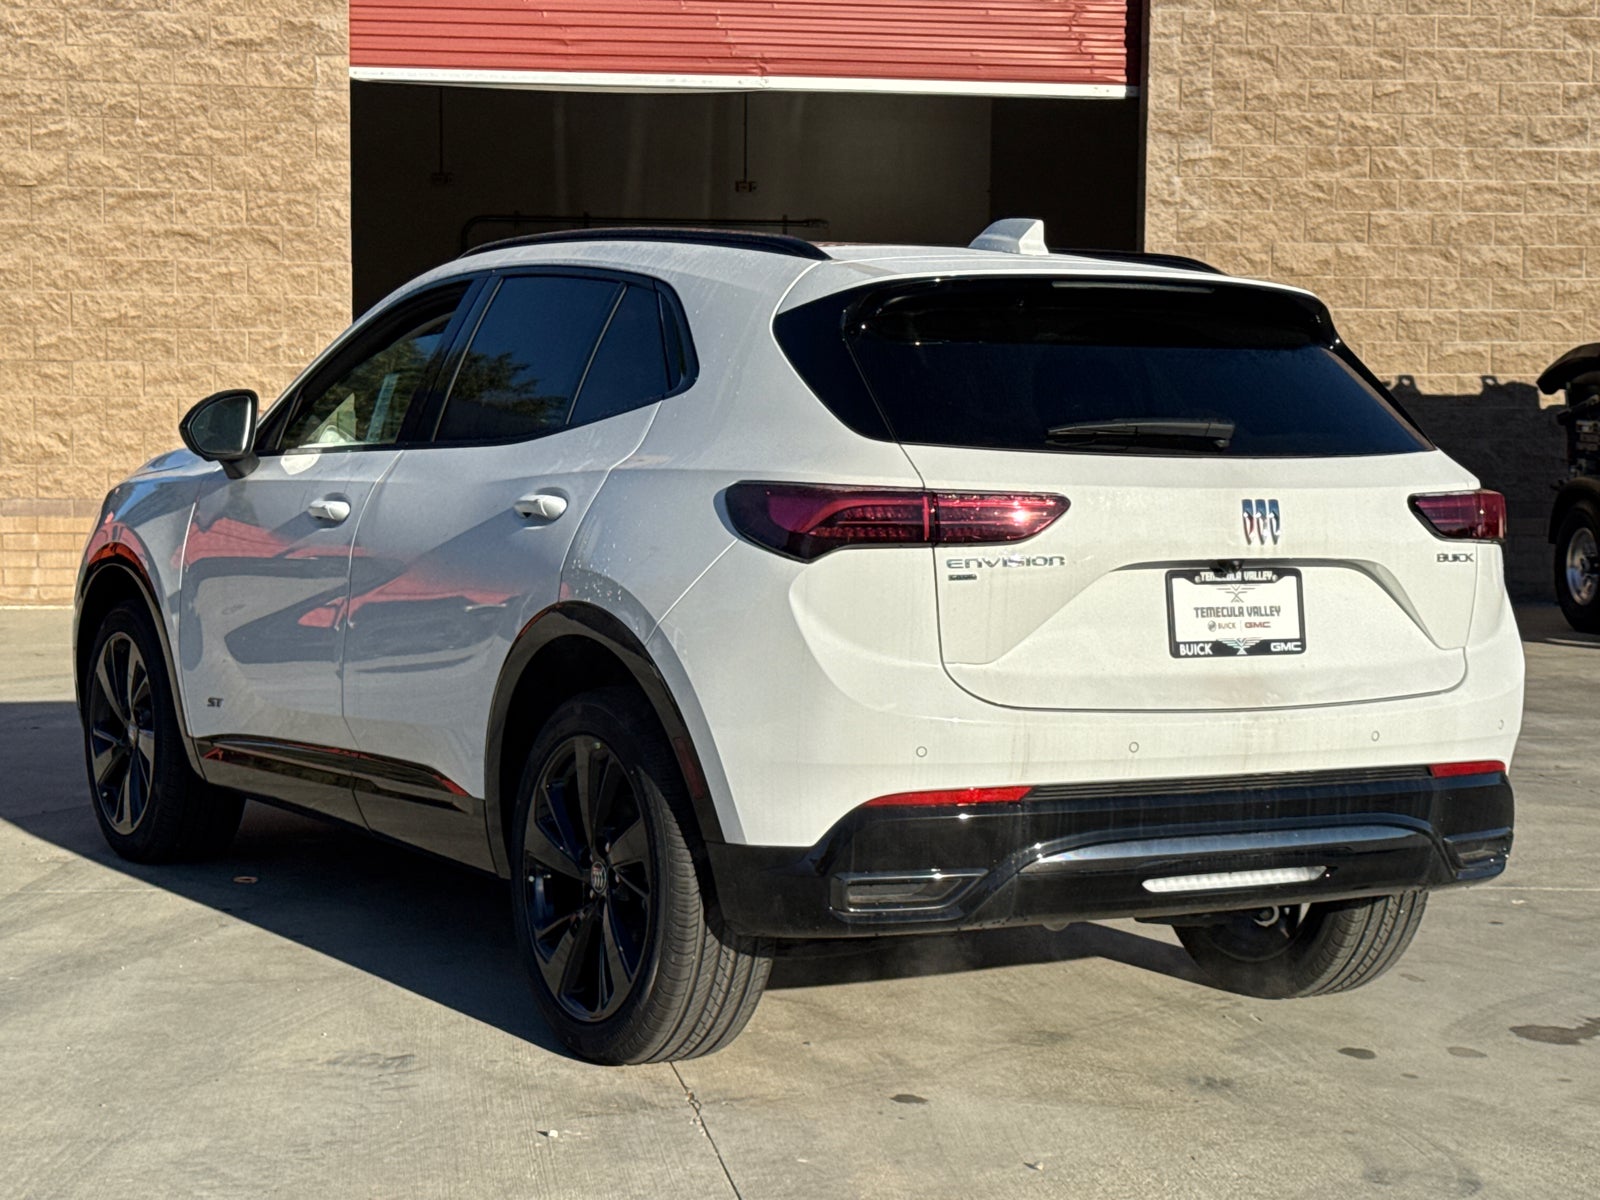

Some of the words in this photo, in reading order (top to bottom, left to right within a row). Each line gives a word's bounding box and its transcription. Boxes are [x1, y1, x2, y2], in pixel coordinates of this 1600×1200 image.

[946, 556, 1065, 568] ENVISION
[1436, 553, 1474, 562] BUICK
[1243, 571, 1273, 581] VALLEY
[1194, 606, 1244, 618] TEMECULA
[1246, 605, 1281, 617] VALLEY
[1179, 643, 1213, 656] BUICK
[1270, 642, 1302, 652] GMC
[207, 696, 224, 707] ST
